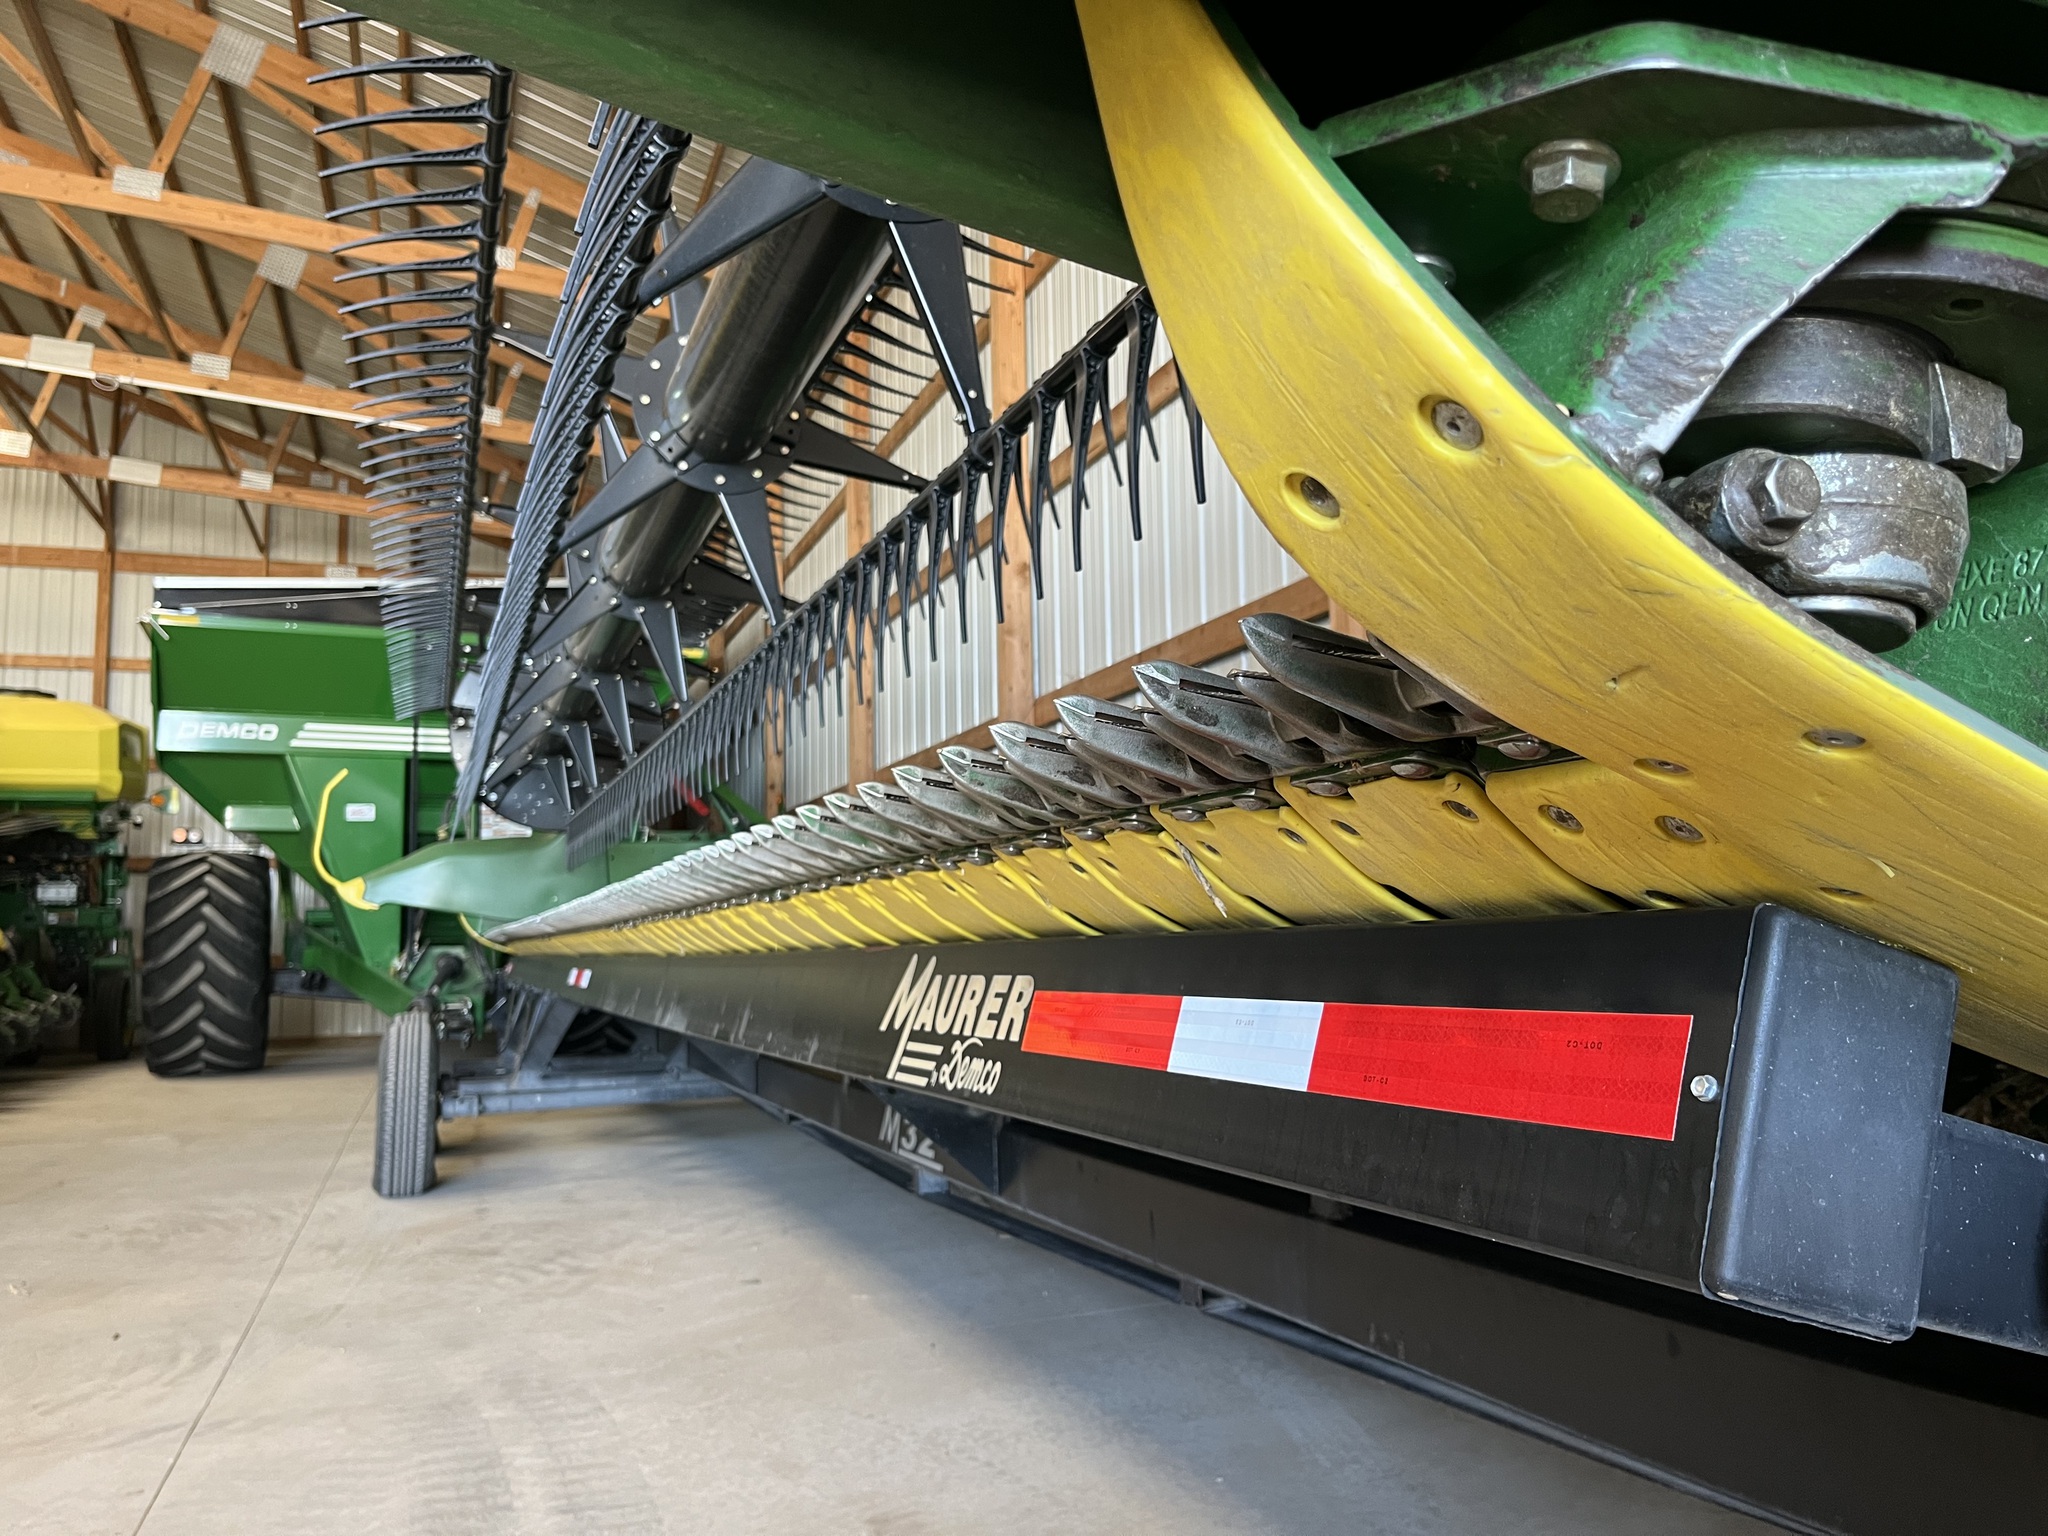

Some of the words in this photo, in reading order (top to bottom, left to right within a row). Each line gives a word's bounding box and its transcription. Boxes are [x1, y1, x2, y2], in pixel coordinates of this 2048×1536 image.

[177, 721, 279, 741] DEMCO
[879, 953, 1035, 1079] MAURER
[1566, 1040, 1603, 1050] DOT-C2
[939, 1037, 1002, 1096] Demco
